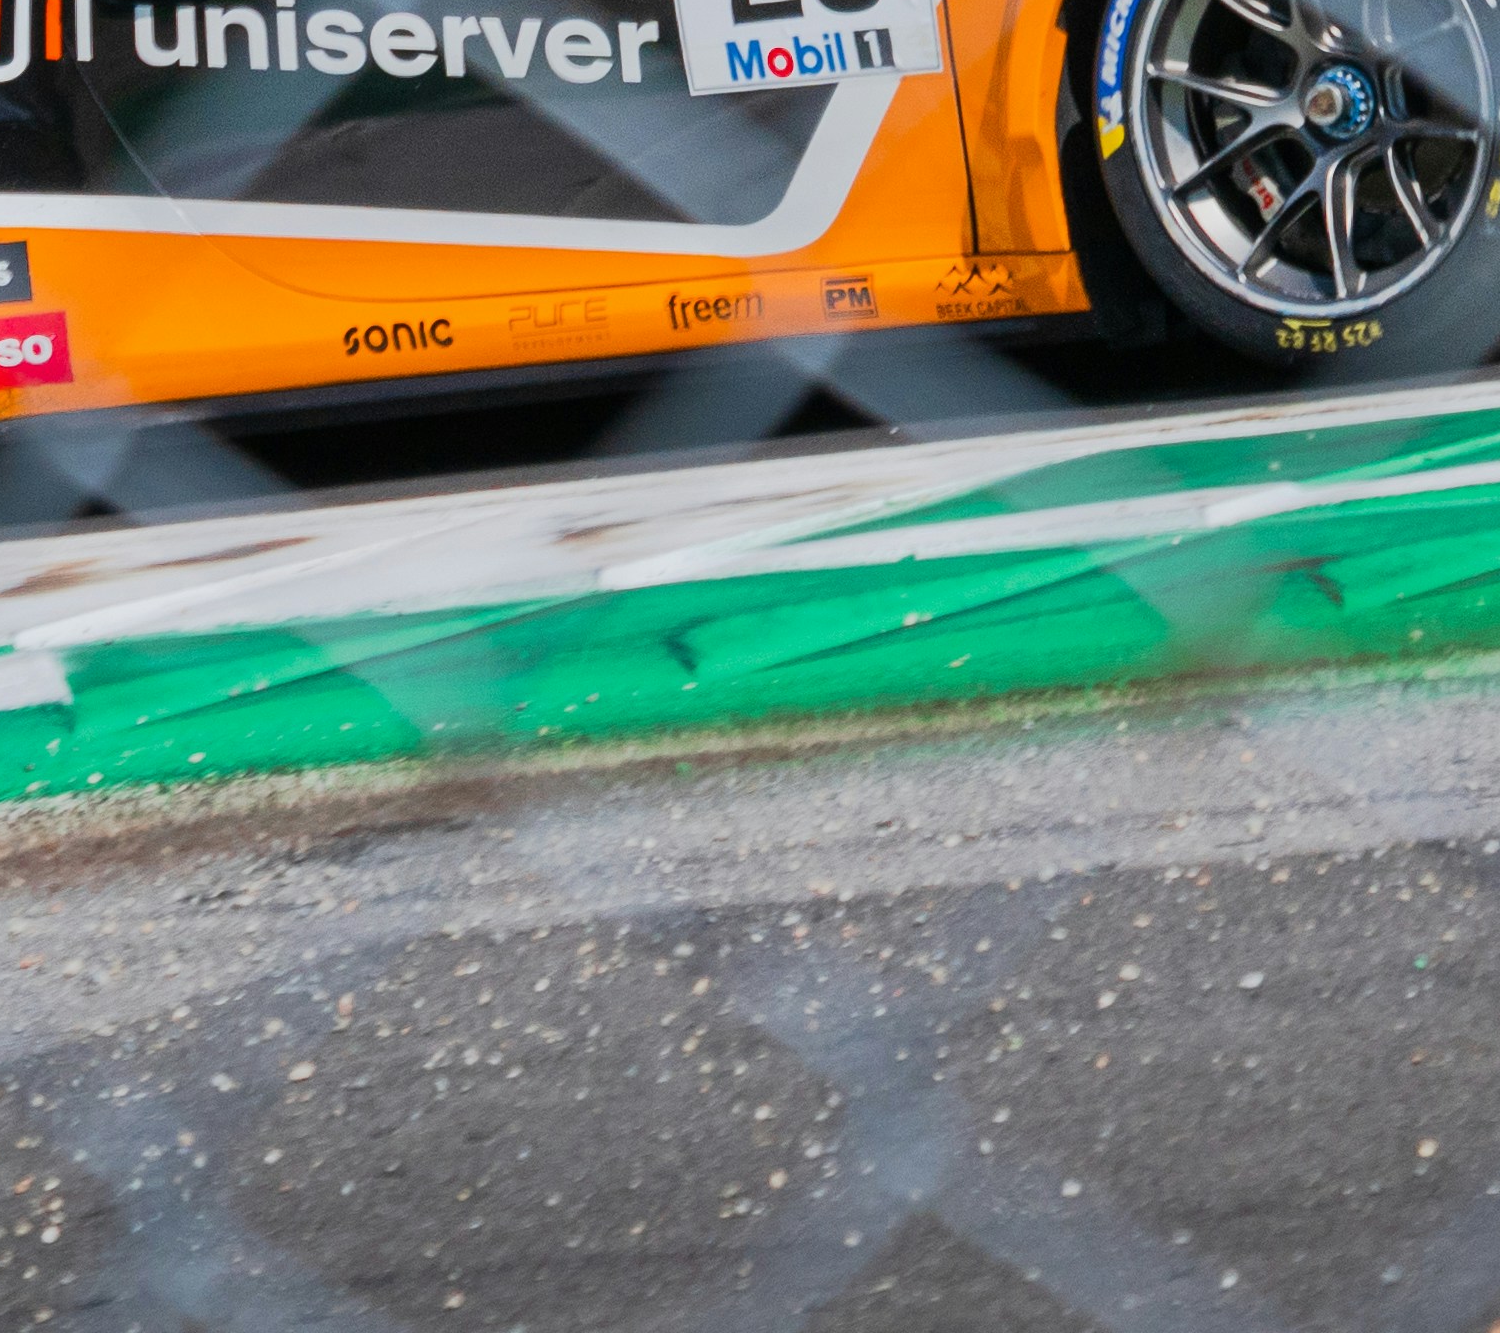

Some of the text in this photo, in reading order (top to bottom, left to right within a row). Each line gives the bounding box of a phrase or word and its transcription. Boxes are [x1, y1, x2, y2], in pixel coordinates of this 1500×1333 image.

[725, 32, 847, 82] Mobil
[668, 291, 765, 331] freem
[825, 286, 872, 310] PM
